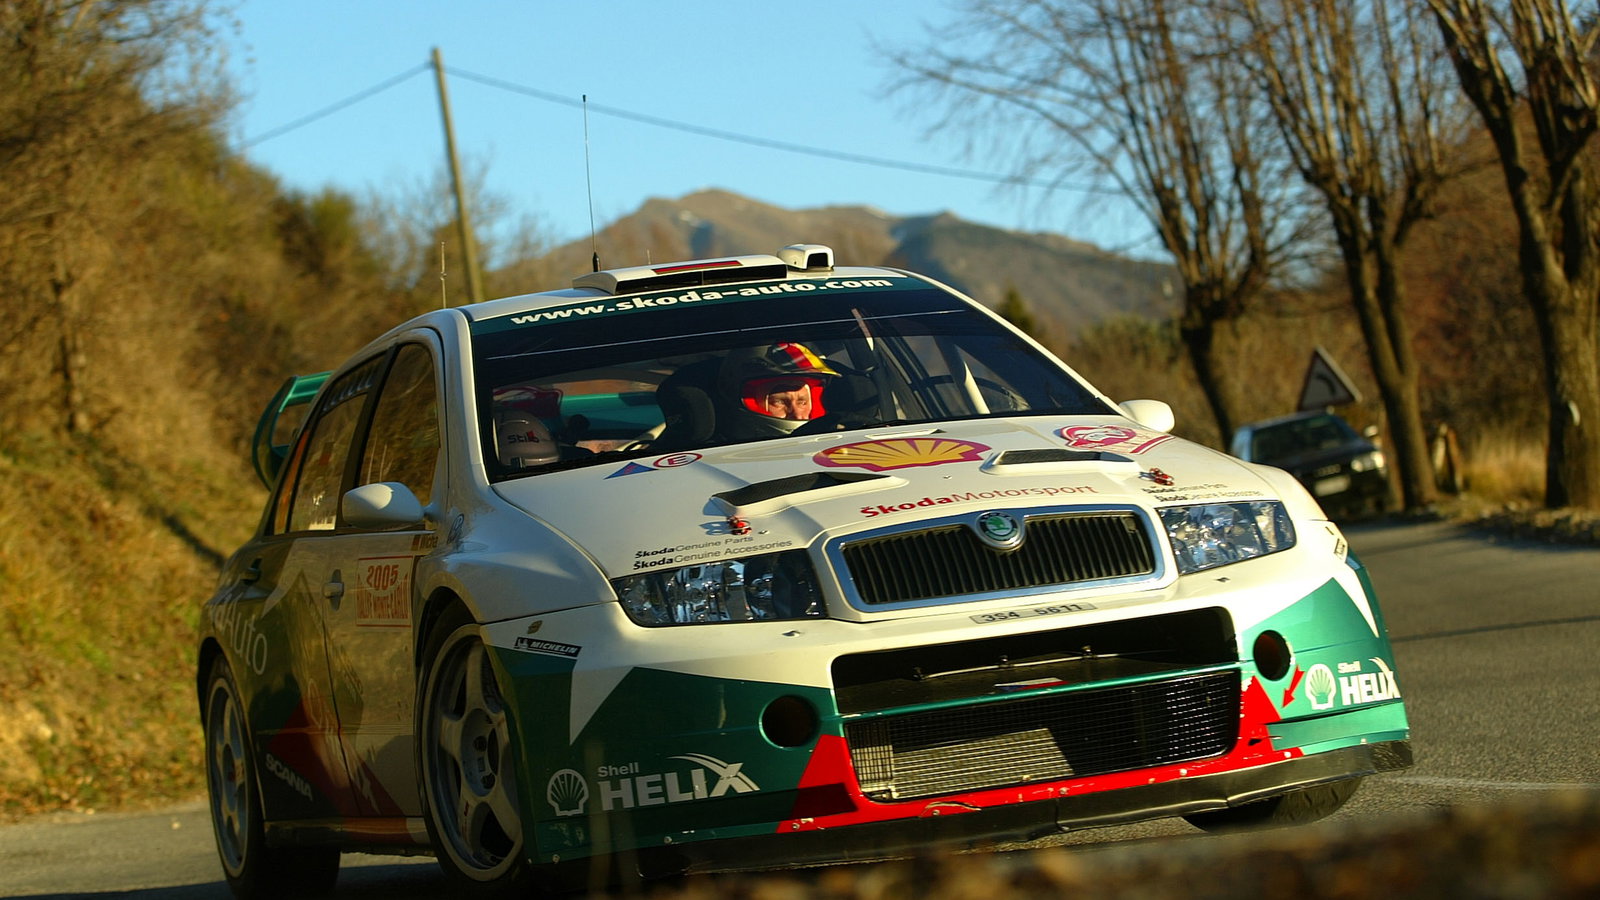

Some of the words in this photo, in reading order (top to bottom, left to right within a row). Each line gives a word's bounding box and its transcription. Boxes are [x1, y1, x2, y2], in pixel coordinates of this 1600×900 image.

[510, 276, 893, 325] www.skoda-auto.com
[724, 536, 754, 545] Parts
[724, 540, 793, 555] Accessories
[366, 564, 400, 590] 2005
[530, 641, 578, 653] MICHELIN
[1338, 659, 1402, 705] HELIX
[265, 753, 313, 802] SCANIA
[597, 762, 639, 777] Shell
[597, 754, 761, 811] HELIX
